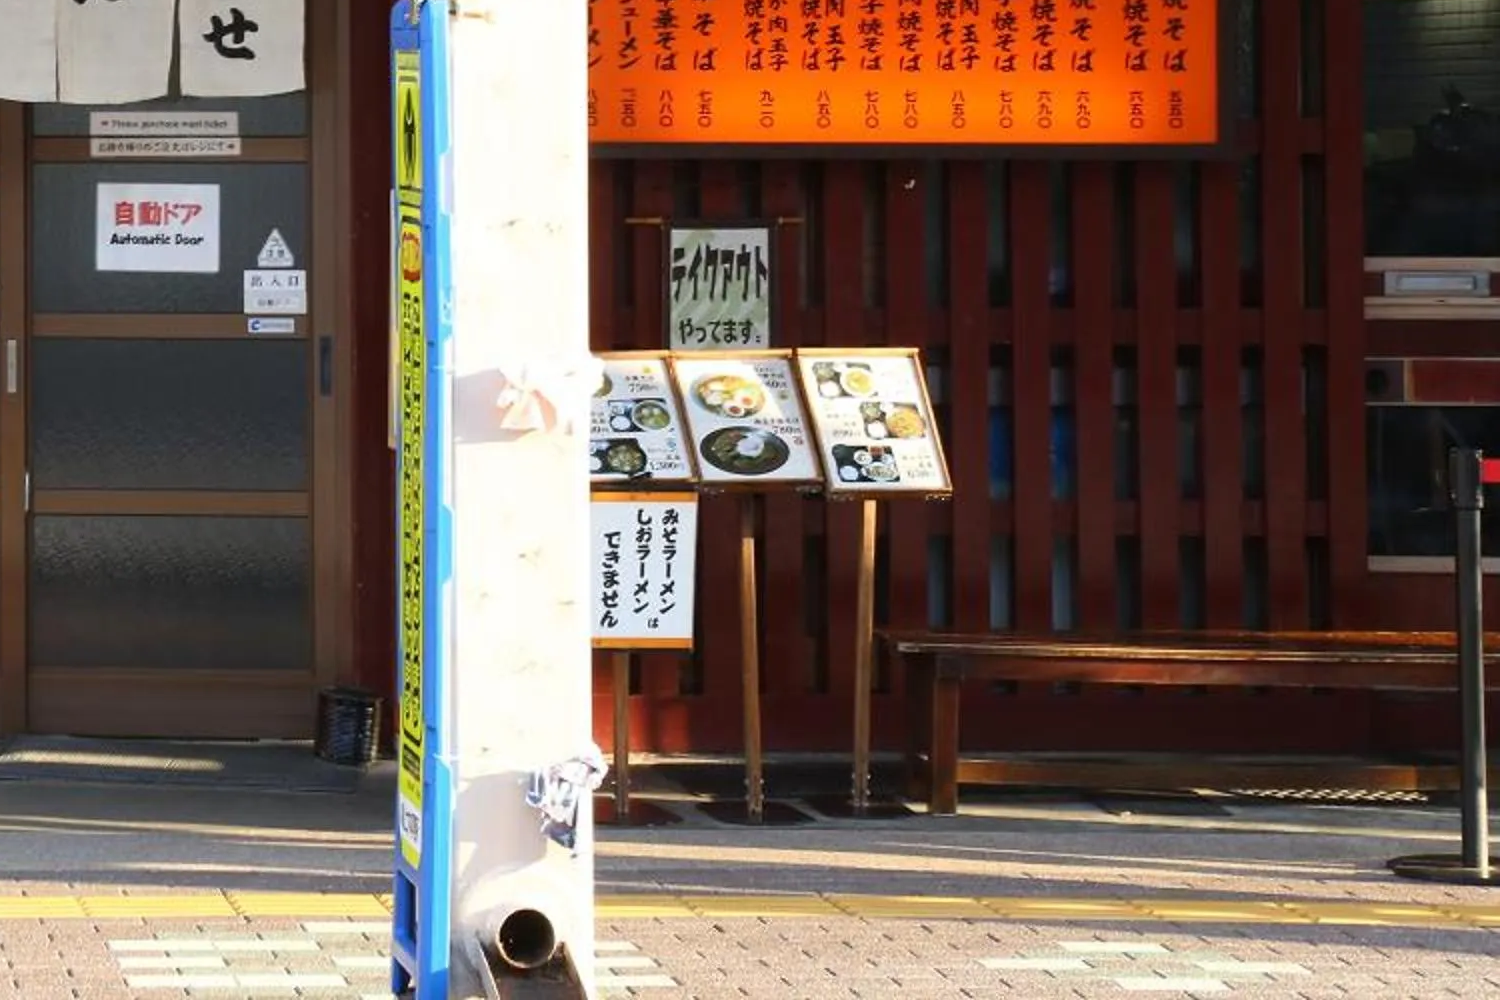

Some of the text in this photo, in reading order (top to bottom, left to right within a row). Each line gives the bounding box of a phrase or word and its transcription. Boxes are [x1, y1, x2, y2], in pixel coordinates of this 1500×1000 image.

[109, 232, 204, 246] Automatic Door
[114, 202, 203, 226] 自動ドア
[672, 243, 768, 302] テイクアウト
[600, 531, 621, 628] できません
[633, 508, 652, 614] しおラーメン
[660, 508, 678, 614] みそラーメン
